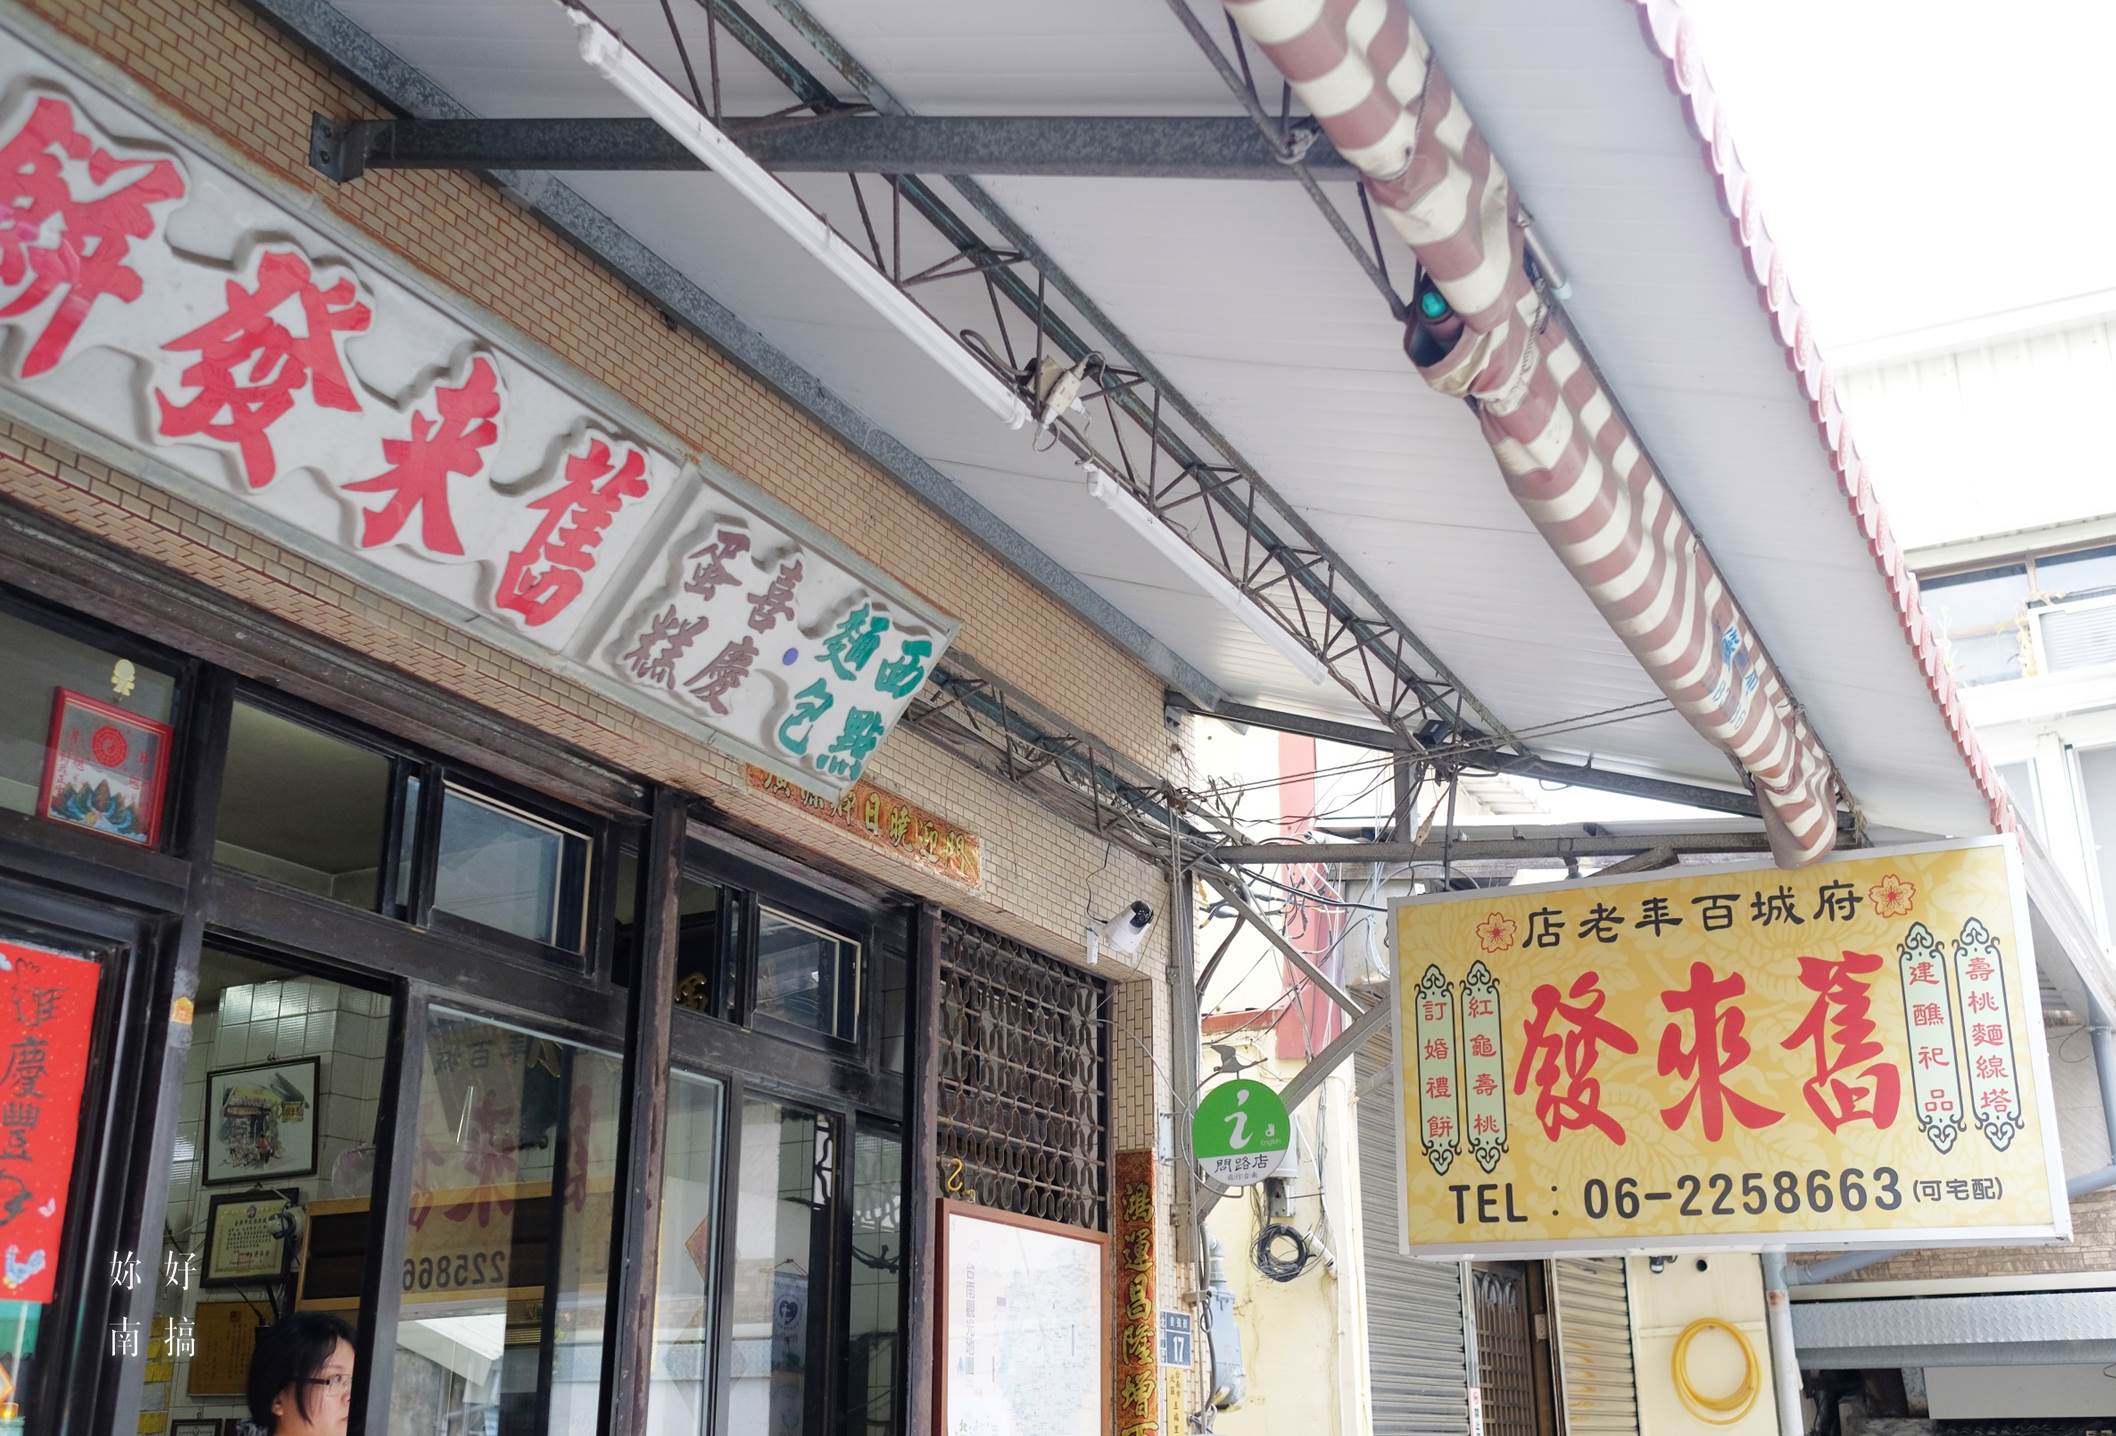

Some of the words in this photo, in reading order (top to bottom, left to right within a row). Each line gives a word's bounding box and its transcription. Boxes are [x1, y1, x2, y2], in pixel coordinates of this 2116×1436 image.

[1214, 1153, 1269, 1173] 問路店
[1583, 1166, 1903, 1220] 06-2258663
[1912, 1176, 2003, 1203] (可宅配)
[1173, 1336, 1185, 1362] 17
